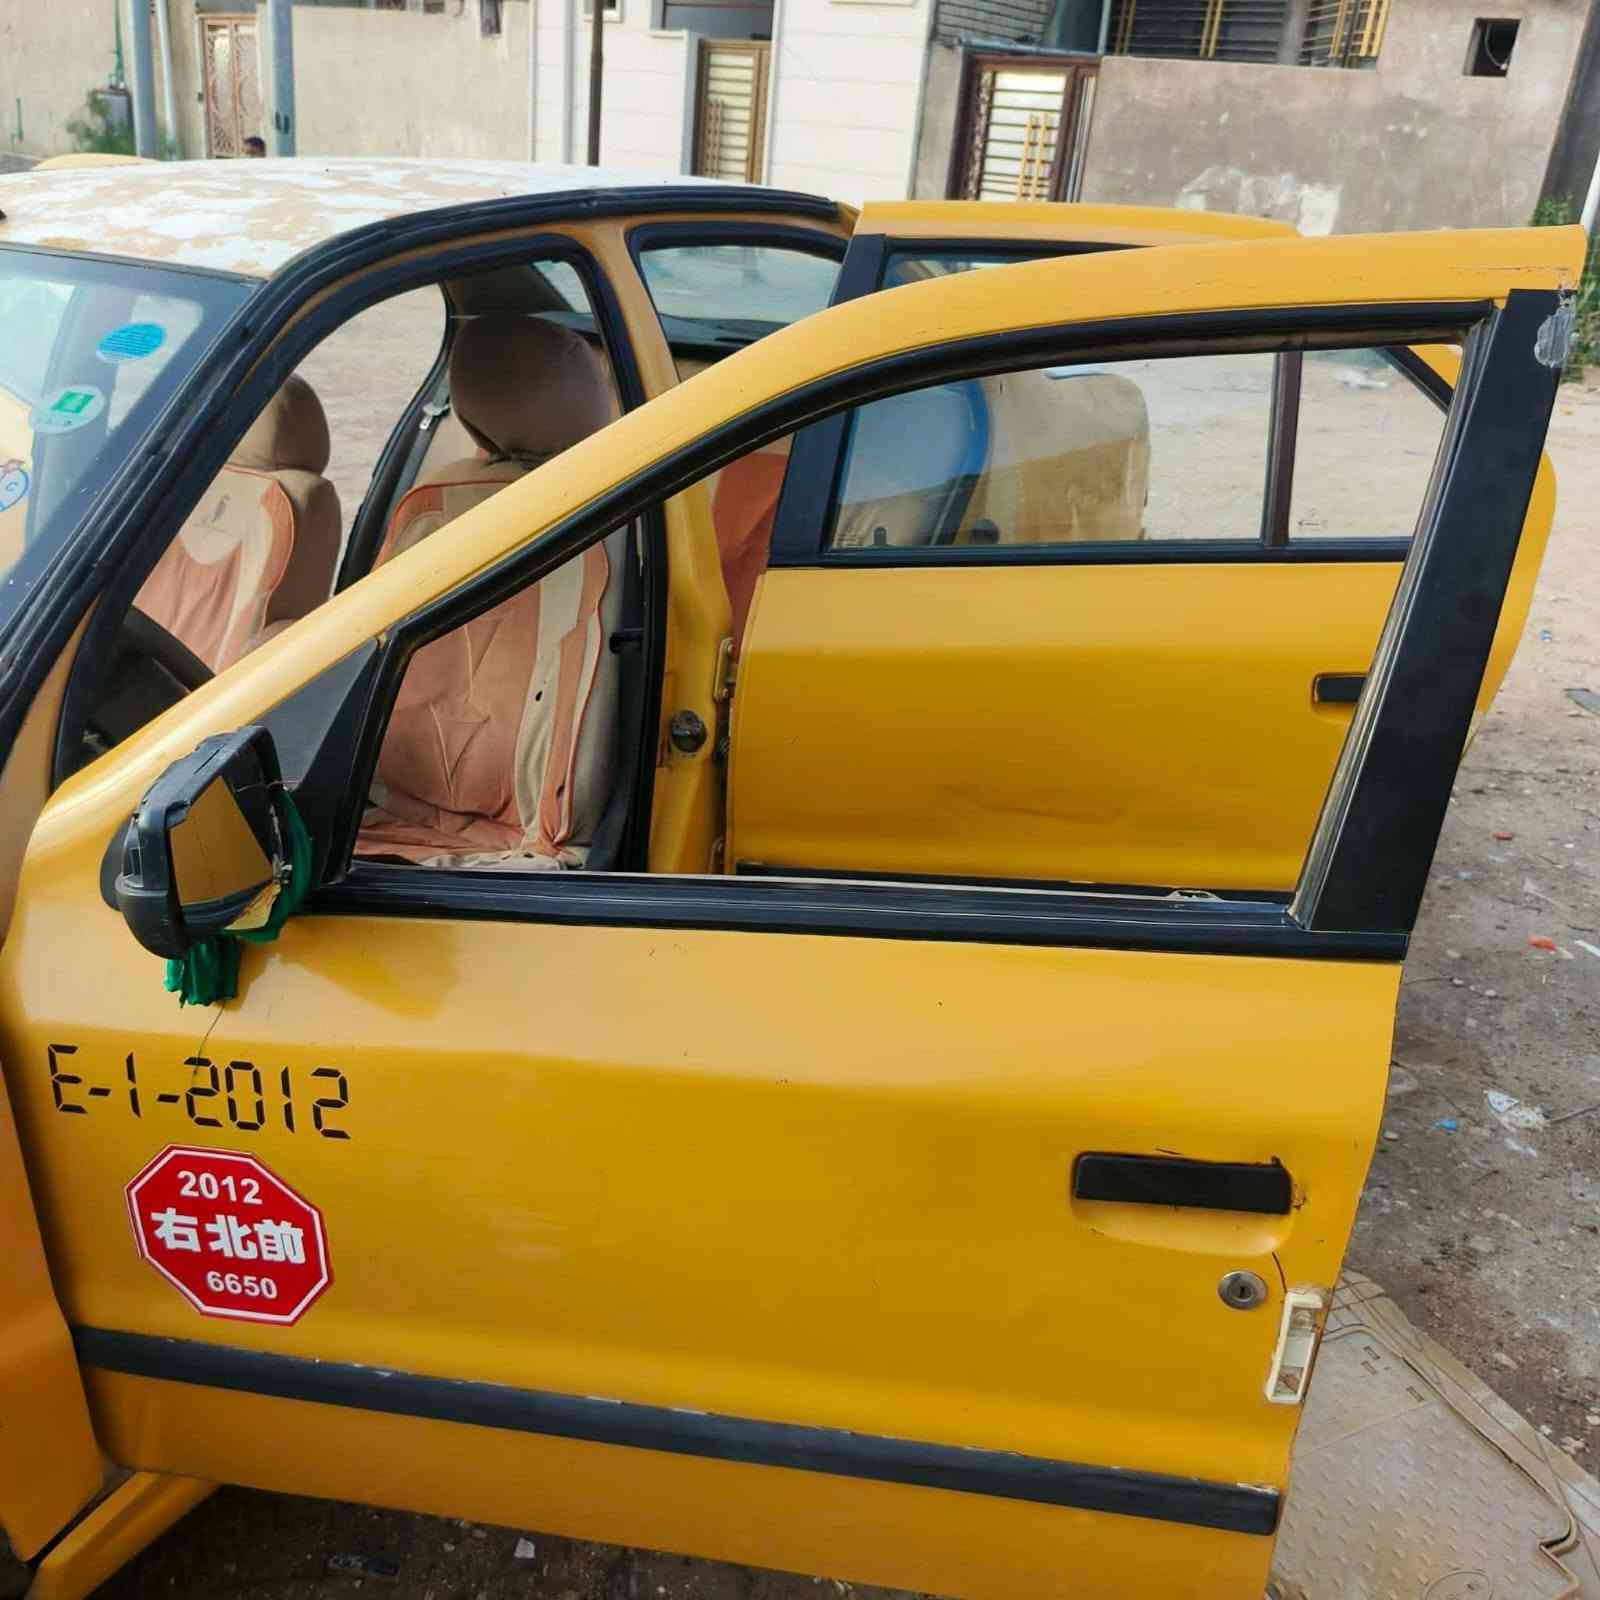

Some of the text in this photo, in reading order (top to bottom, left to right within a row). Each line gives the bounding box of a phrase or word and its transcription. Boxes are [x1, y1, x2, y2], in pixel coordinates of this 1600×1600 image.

[48, 1044, 351, 1139] E-1-2012
[177, 1170, 263, 1205] 2012
[206, 1271, 278, 1299] 6650
